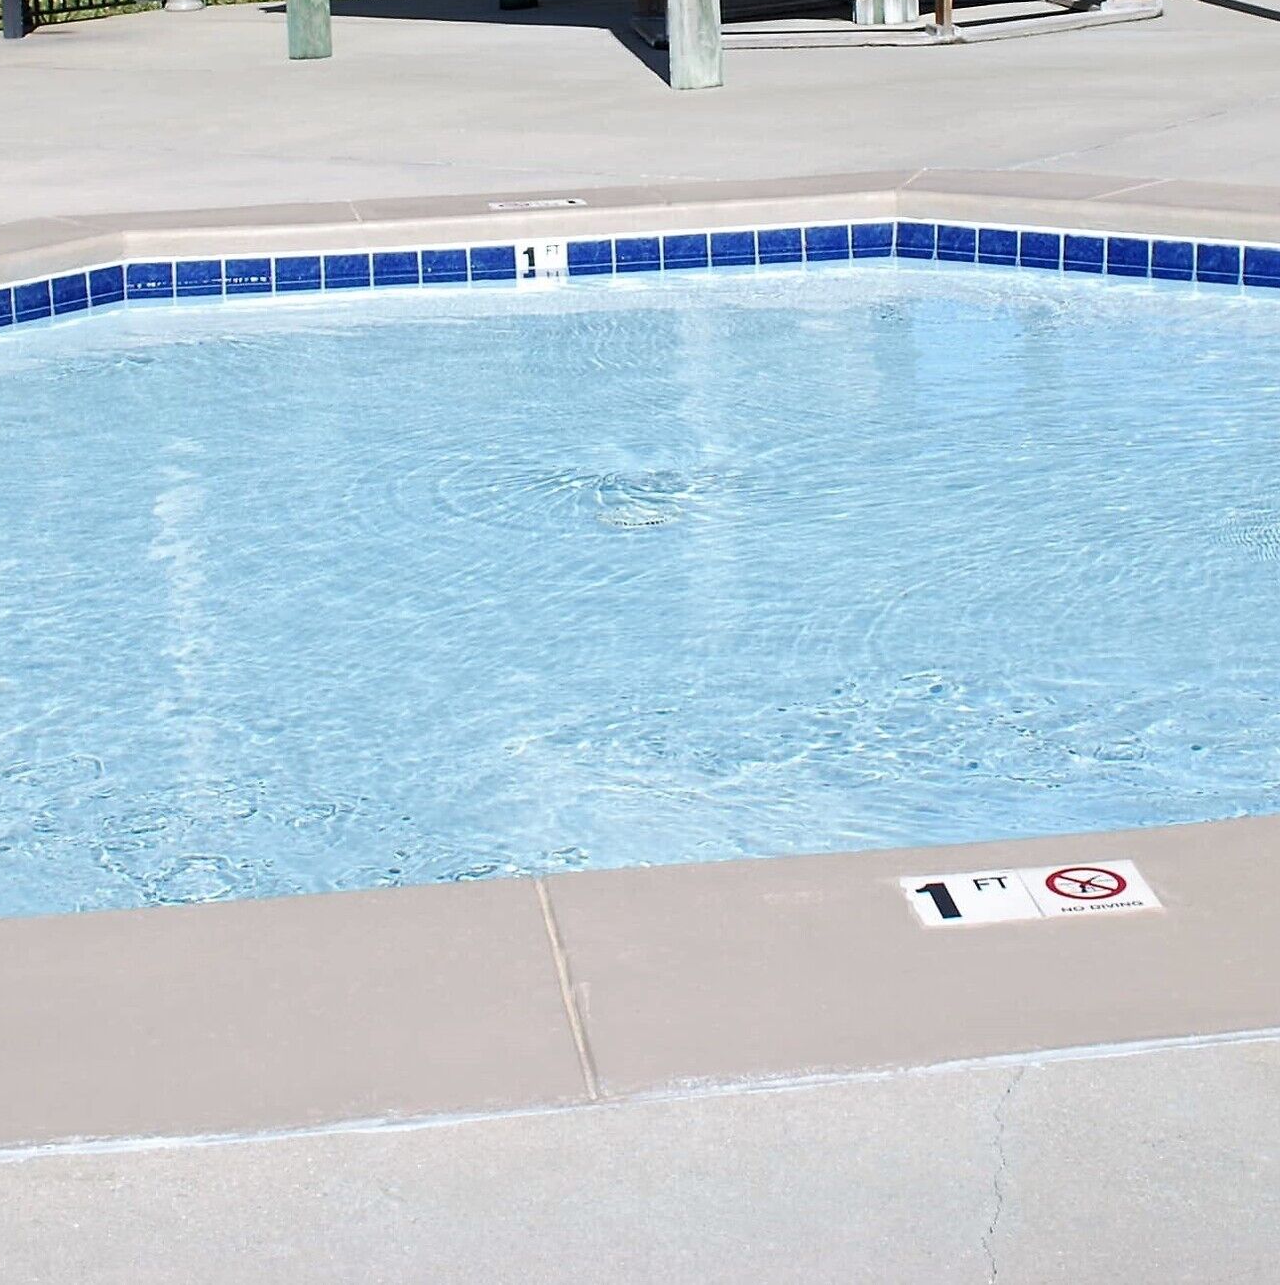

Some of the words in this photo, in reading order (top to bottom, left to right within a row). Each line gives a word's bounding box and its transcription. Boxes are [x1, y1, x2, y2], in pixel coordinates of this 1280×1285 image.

[523, 247, 535, 267] 1
[546, 245, 560, 255] FT
[915, 882, 962, 919] 1
[973, 876, 1008, 891] FT
[1090, 901, 1143, 910] DIVING
